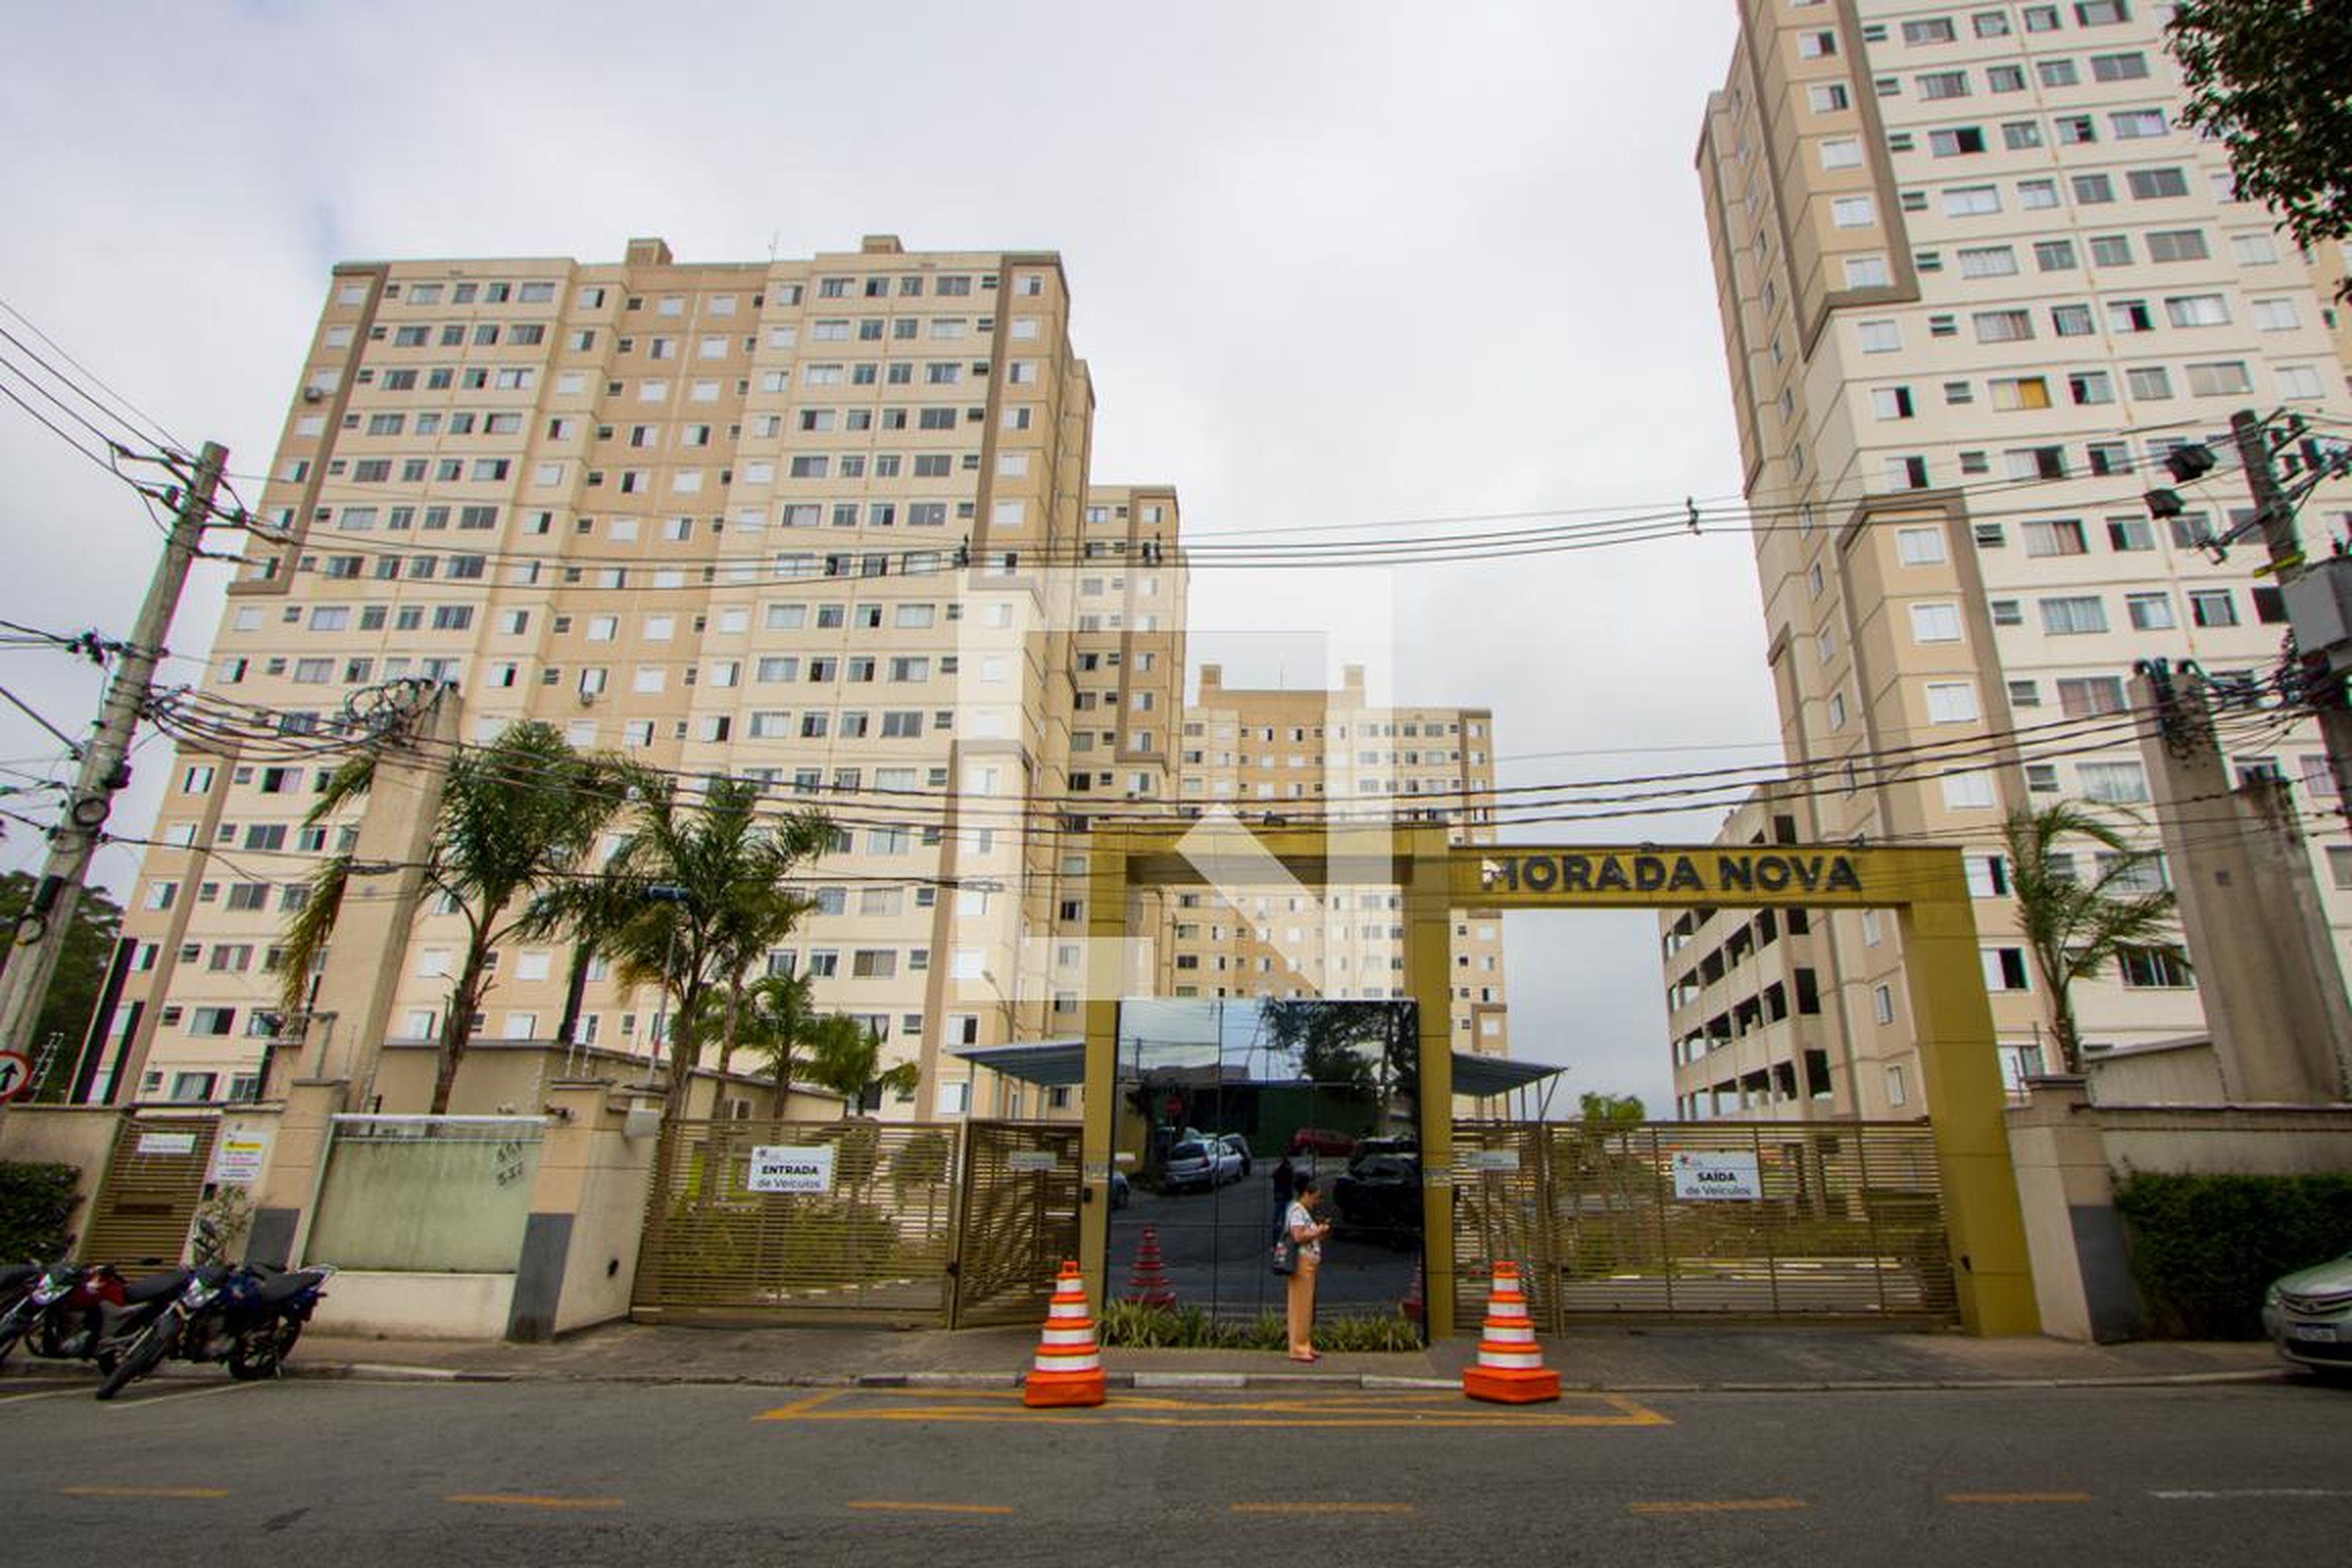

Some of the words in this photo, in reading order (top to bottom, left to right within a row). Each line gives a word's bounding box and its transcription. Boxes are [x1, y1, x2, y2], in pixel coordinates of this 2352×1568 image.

[1481, 853, 1703, 891] MORADA
[1718, 856, 1863, 891] NOVA
[762, 1165, 819, 1175] ENTRADA
[1697, 1169, 1738, 1182] SAÍDA
[757, 1178, 771, 1188] de
[1685, 1185, 1700, 1195] de
